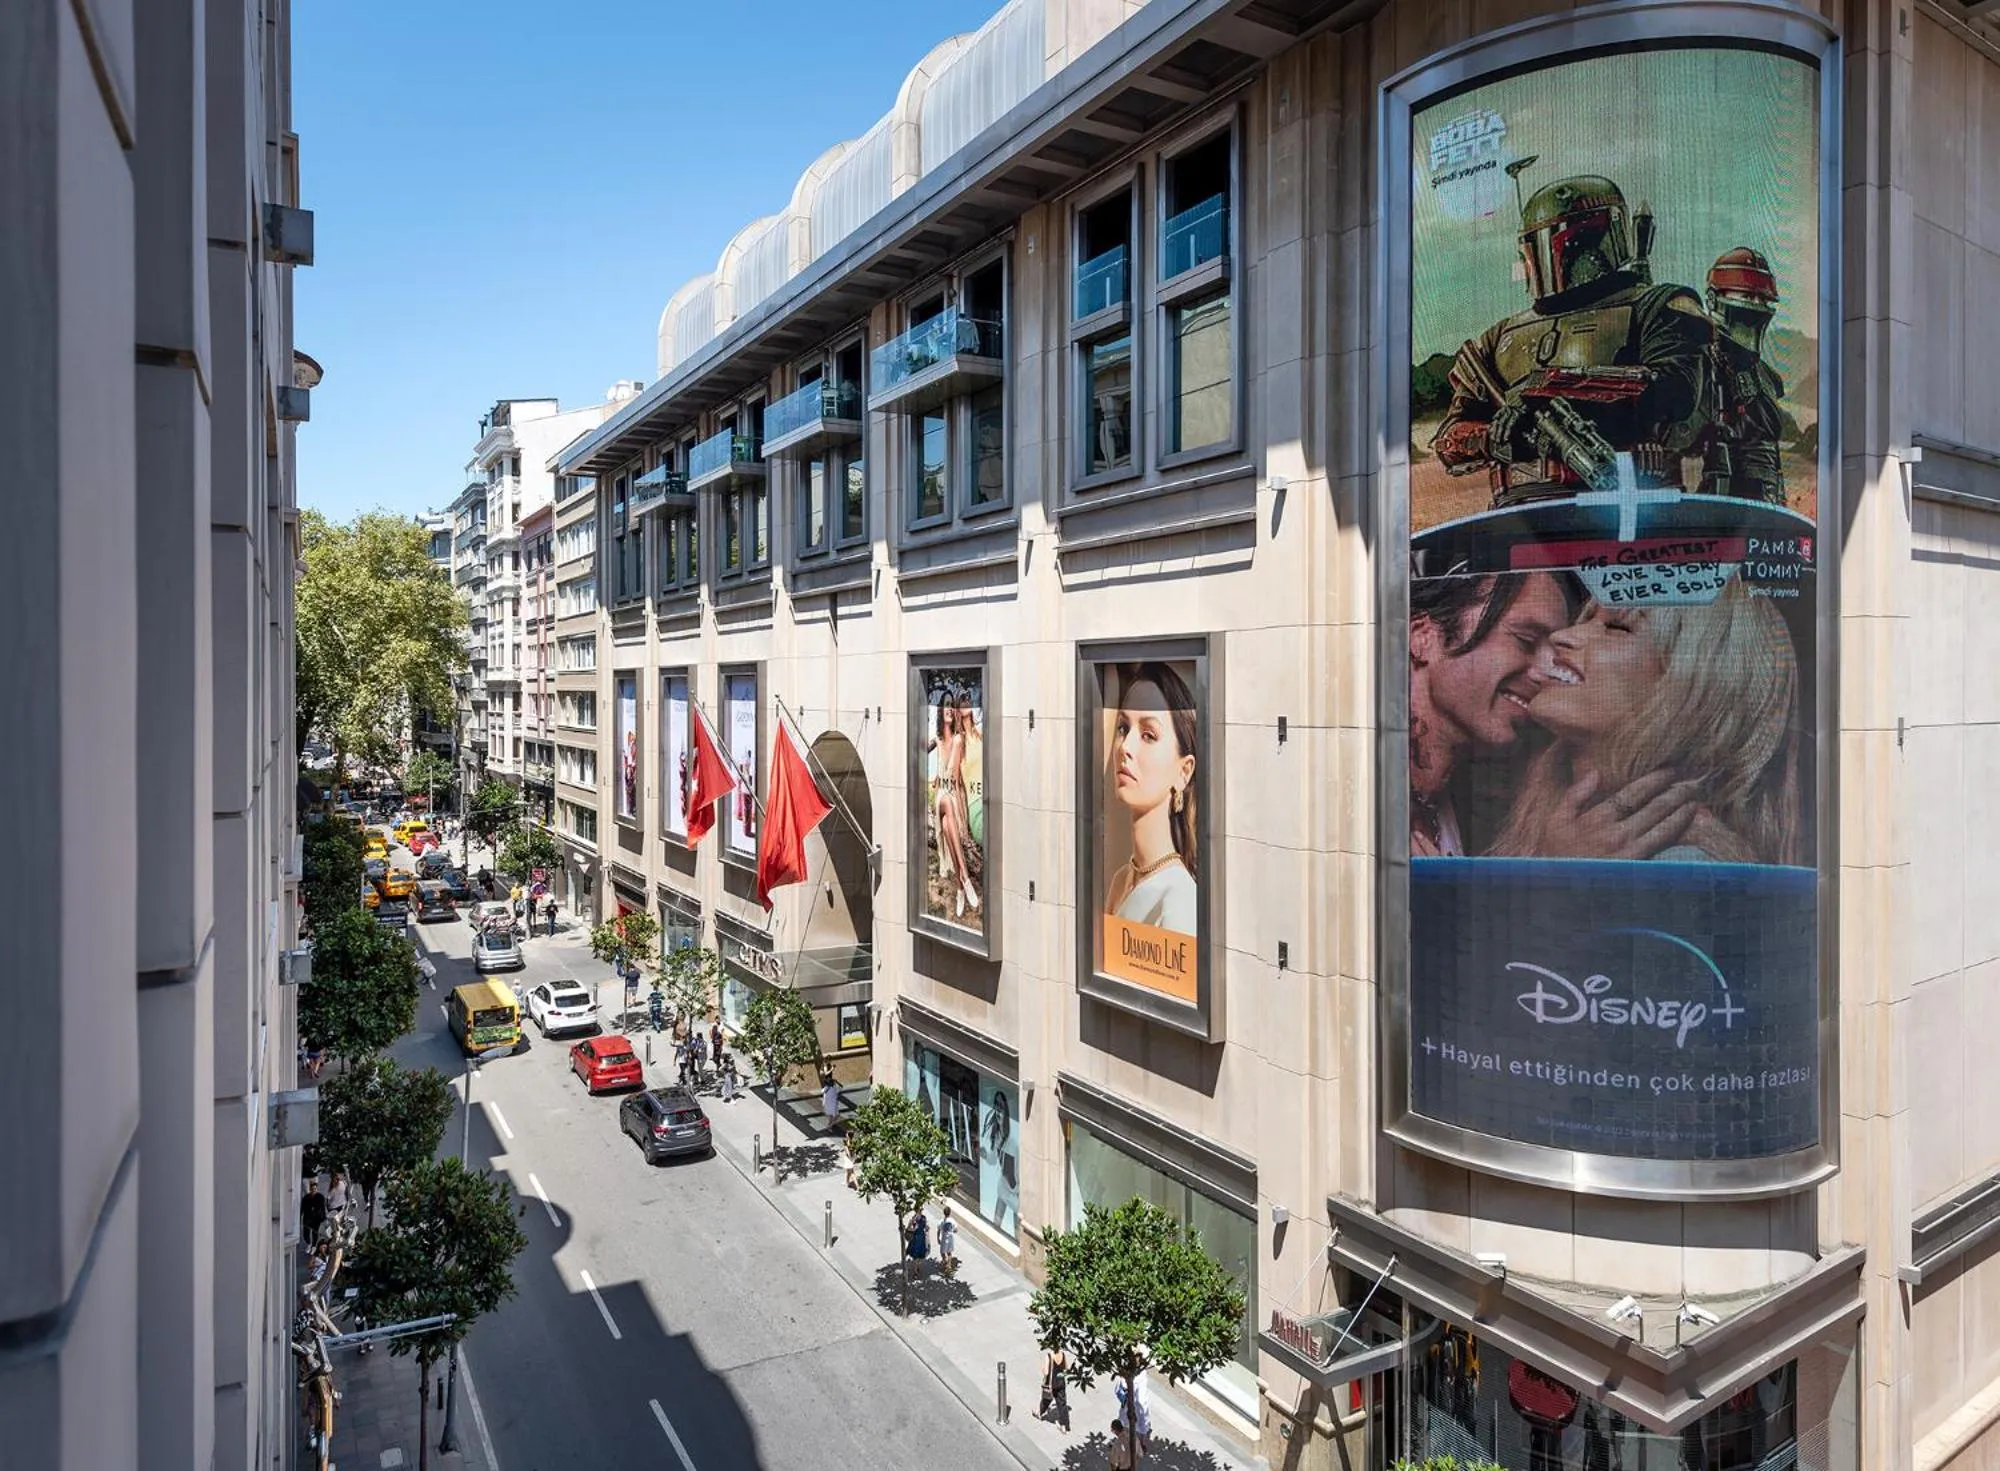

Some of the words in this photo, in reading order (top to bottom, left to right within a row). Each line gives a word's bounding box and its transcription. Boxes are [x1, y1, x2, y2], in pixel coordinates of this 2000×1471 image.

[1577, 554, 1609, 571] THE
[1616, 540, 1719, 565] GREATEST
[1744, 561, 1801, 579] TOMMY
[1602, 567, 1649, 588] LOVE
[1655, 559, 1722, 577] STORY
[1609, 582, 1668, 602] EVER
[1676, 577, 1726, 594] SOLD
[1122, 927, 1162, 965] DIAMOND
[1164, 938, 1187, 974] LINE
[1509, 1059, 1640, 1089] ettiğinden
[1650, 1074, 1695, 1096] çok
[1702, 1073, 1755, 1092] daha
[1760, 1066, 1811, 1089] fazlası
